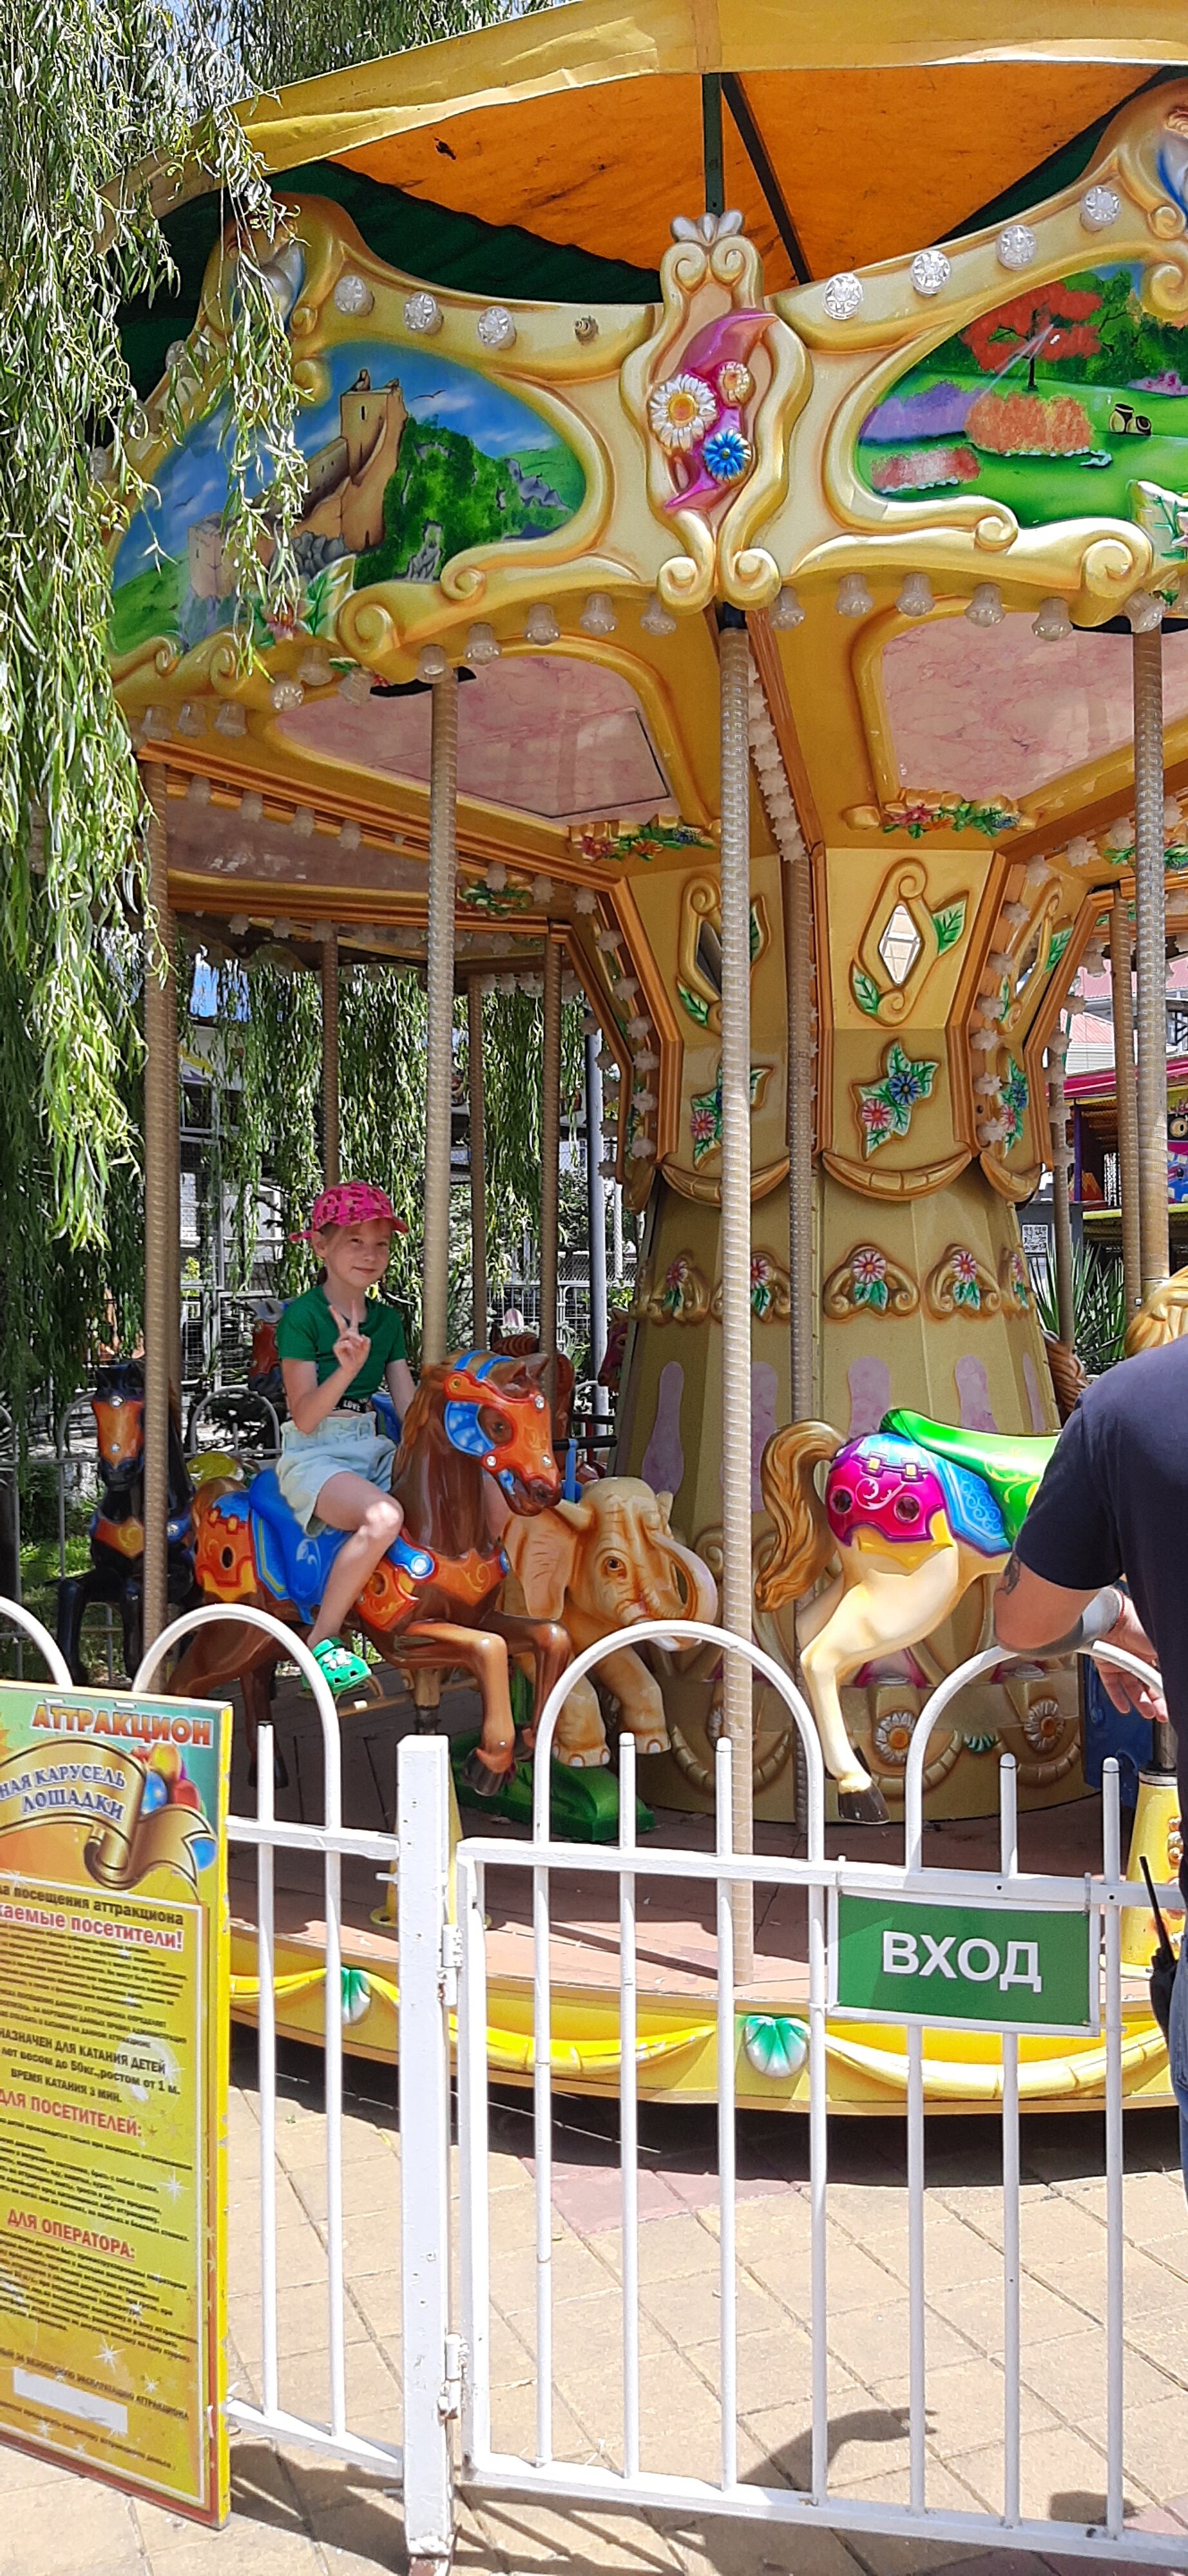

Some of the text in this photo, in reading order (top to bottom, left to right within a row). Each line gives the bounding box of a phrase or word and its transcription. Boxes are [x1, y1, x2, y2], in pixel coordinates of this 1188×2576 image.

[32, 1703, 211, 1746] АТТРАКЦИОН
[34, 1765, 125, 1788] КАРУСЕЛЬ
[23, 1788, 124, 1820] ЛОШАДКИ
[14, 1887, 90, 1909] посещения
[93, 1900, 184, 1925] аттракциона
[71, 1917, 183, 1949] посетители!
[883, 1930, 1042, 1993] ВХОД
[55, 2040, 77, 2053] ДЛЯ
[79, 2045, 128, 2066] КАТАНИЯ
[131, 2056, 166, 2075] ДЕТЕЙ
[45, 2076, 88, 2094] КАТАНИЯ
[55, 2060, 68, 2070] до
[143, 2079, 156, 2088] от
[158, 2081, 166, 2092] 1
[31, 2096, 142, 2137] ПОСЕТИТЕЛЕЙ:
[8, 2208, 135, 2259] ДЛЯ ОПЕРАТОРА:
